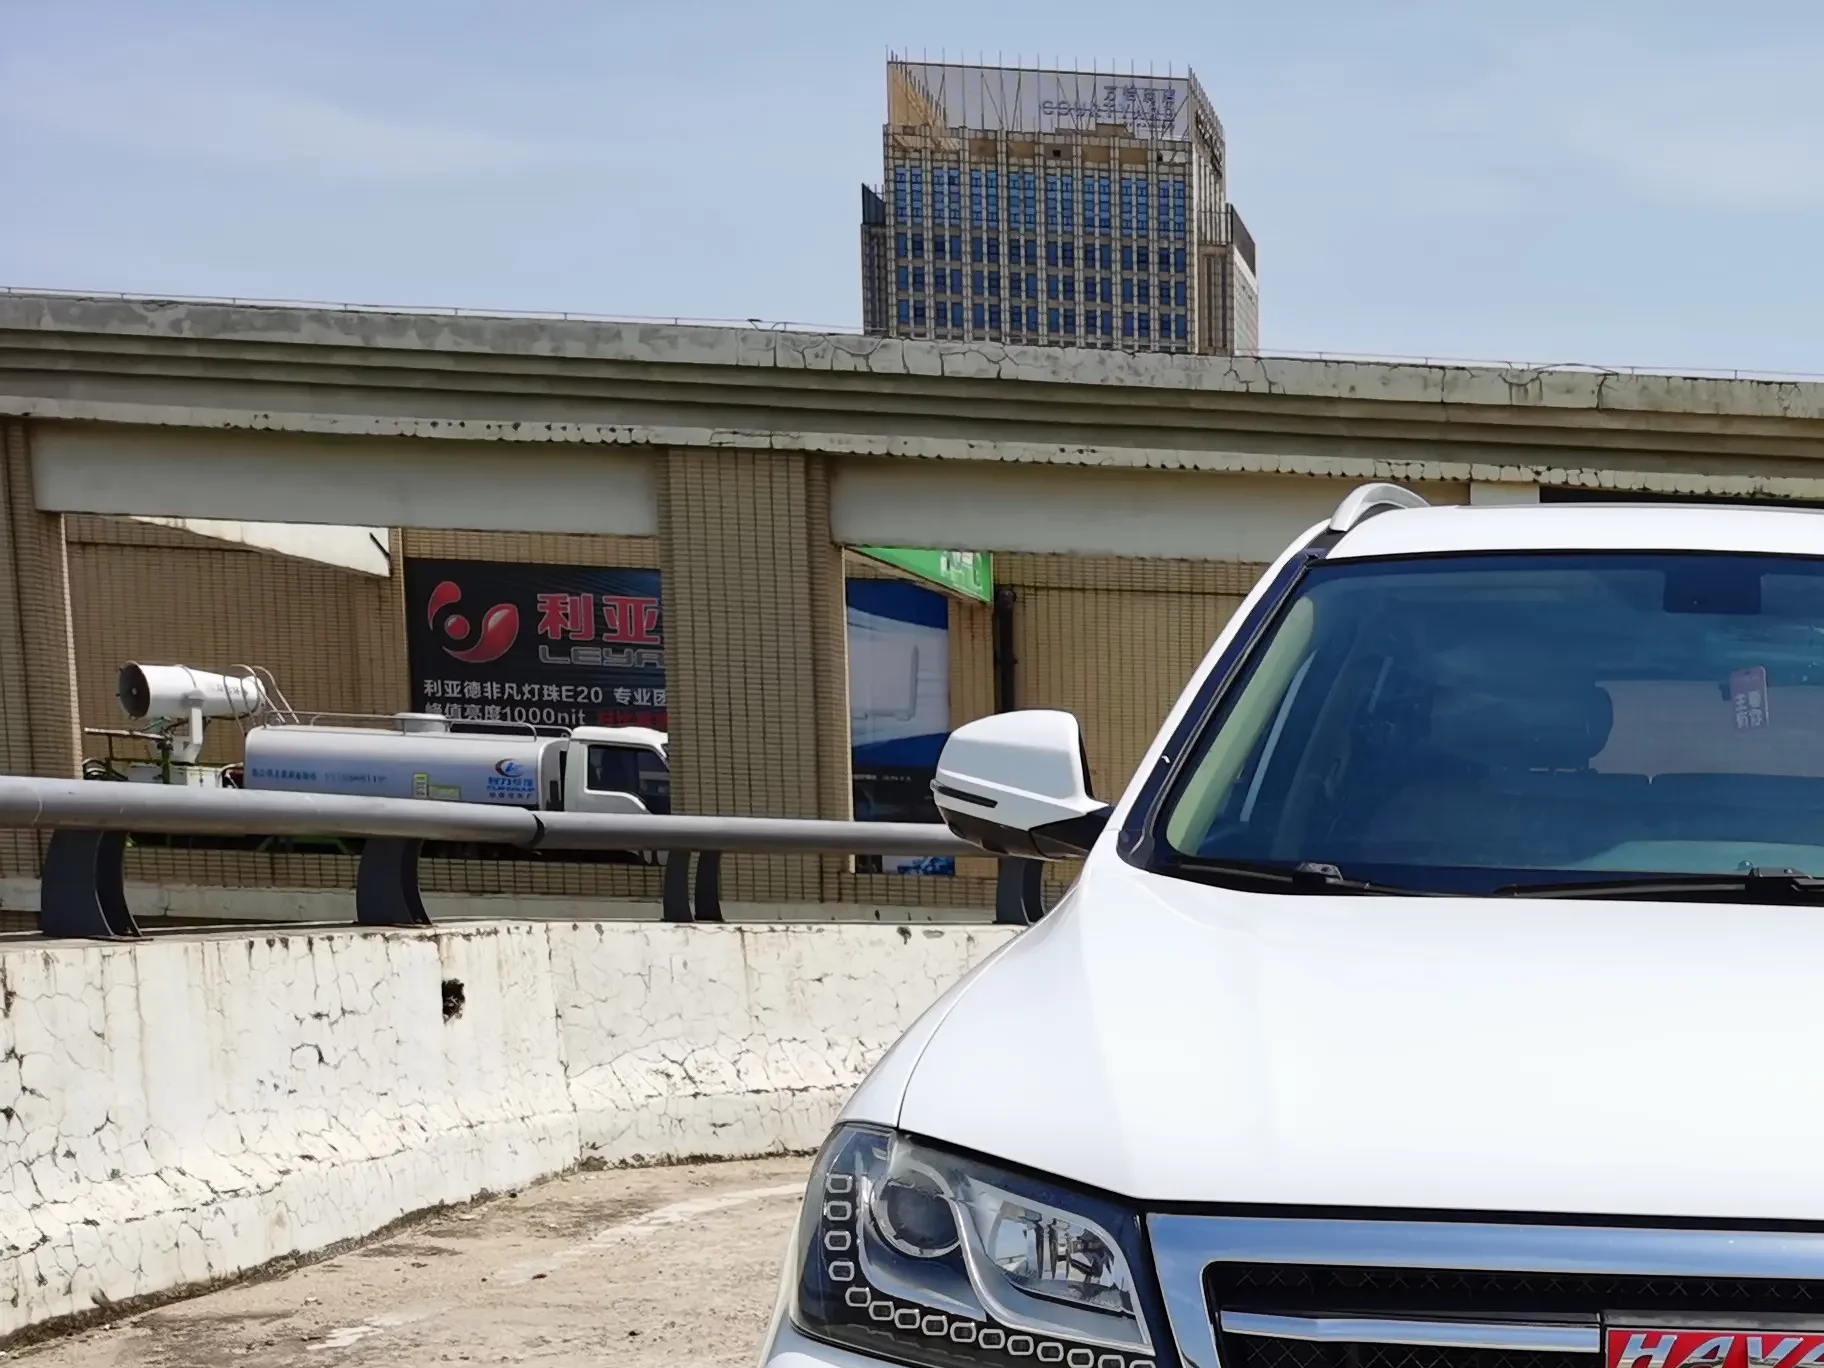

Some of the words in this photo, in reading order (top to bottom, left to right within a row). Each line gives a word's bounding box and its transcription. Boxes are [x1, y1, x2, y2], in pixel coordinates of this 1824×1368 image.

[537, 593, 660, 644] 利亚
[424, 679, 603, 704] 利亚德非凡灯珠E20
[613, 686, 667, 707] 专业团
